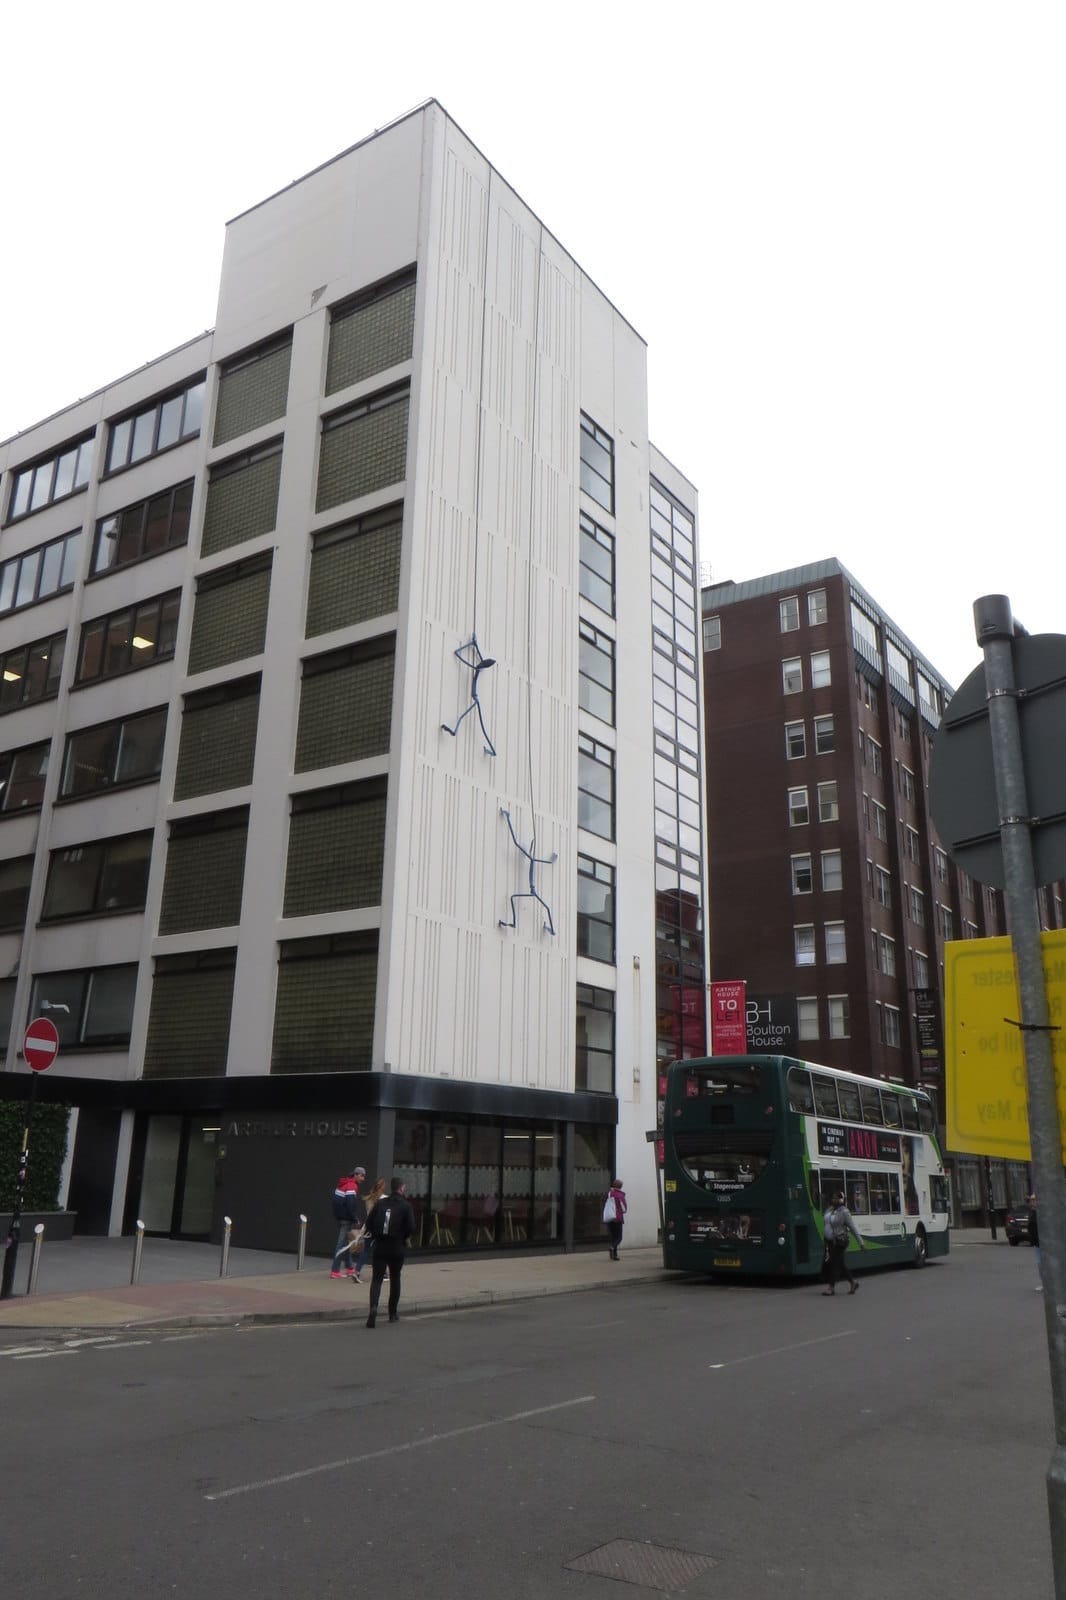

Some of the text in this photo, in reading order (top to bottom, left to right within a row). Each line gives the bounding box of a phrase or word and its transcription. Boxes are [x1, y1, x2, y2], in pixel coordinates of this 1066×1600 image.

[719, 999, 737, 1011] TO
[716, 1010, 741, 1022] LET
[746, 1024, 791, 1036] Boulton
[747, 1035, 784, 1047] House
[303, 1120, 369, 1136] HOUSE
